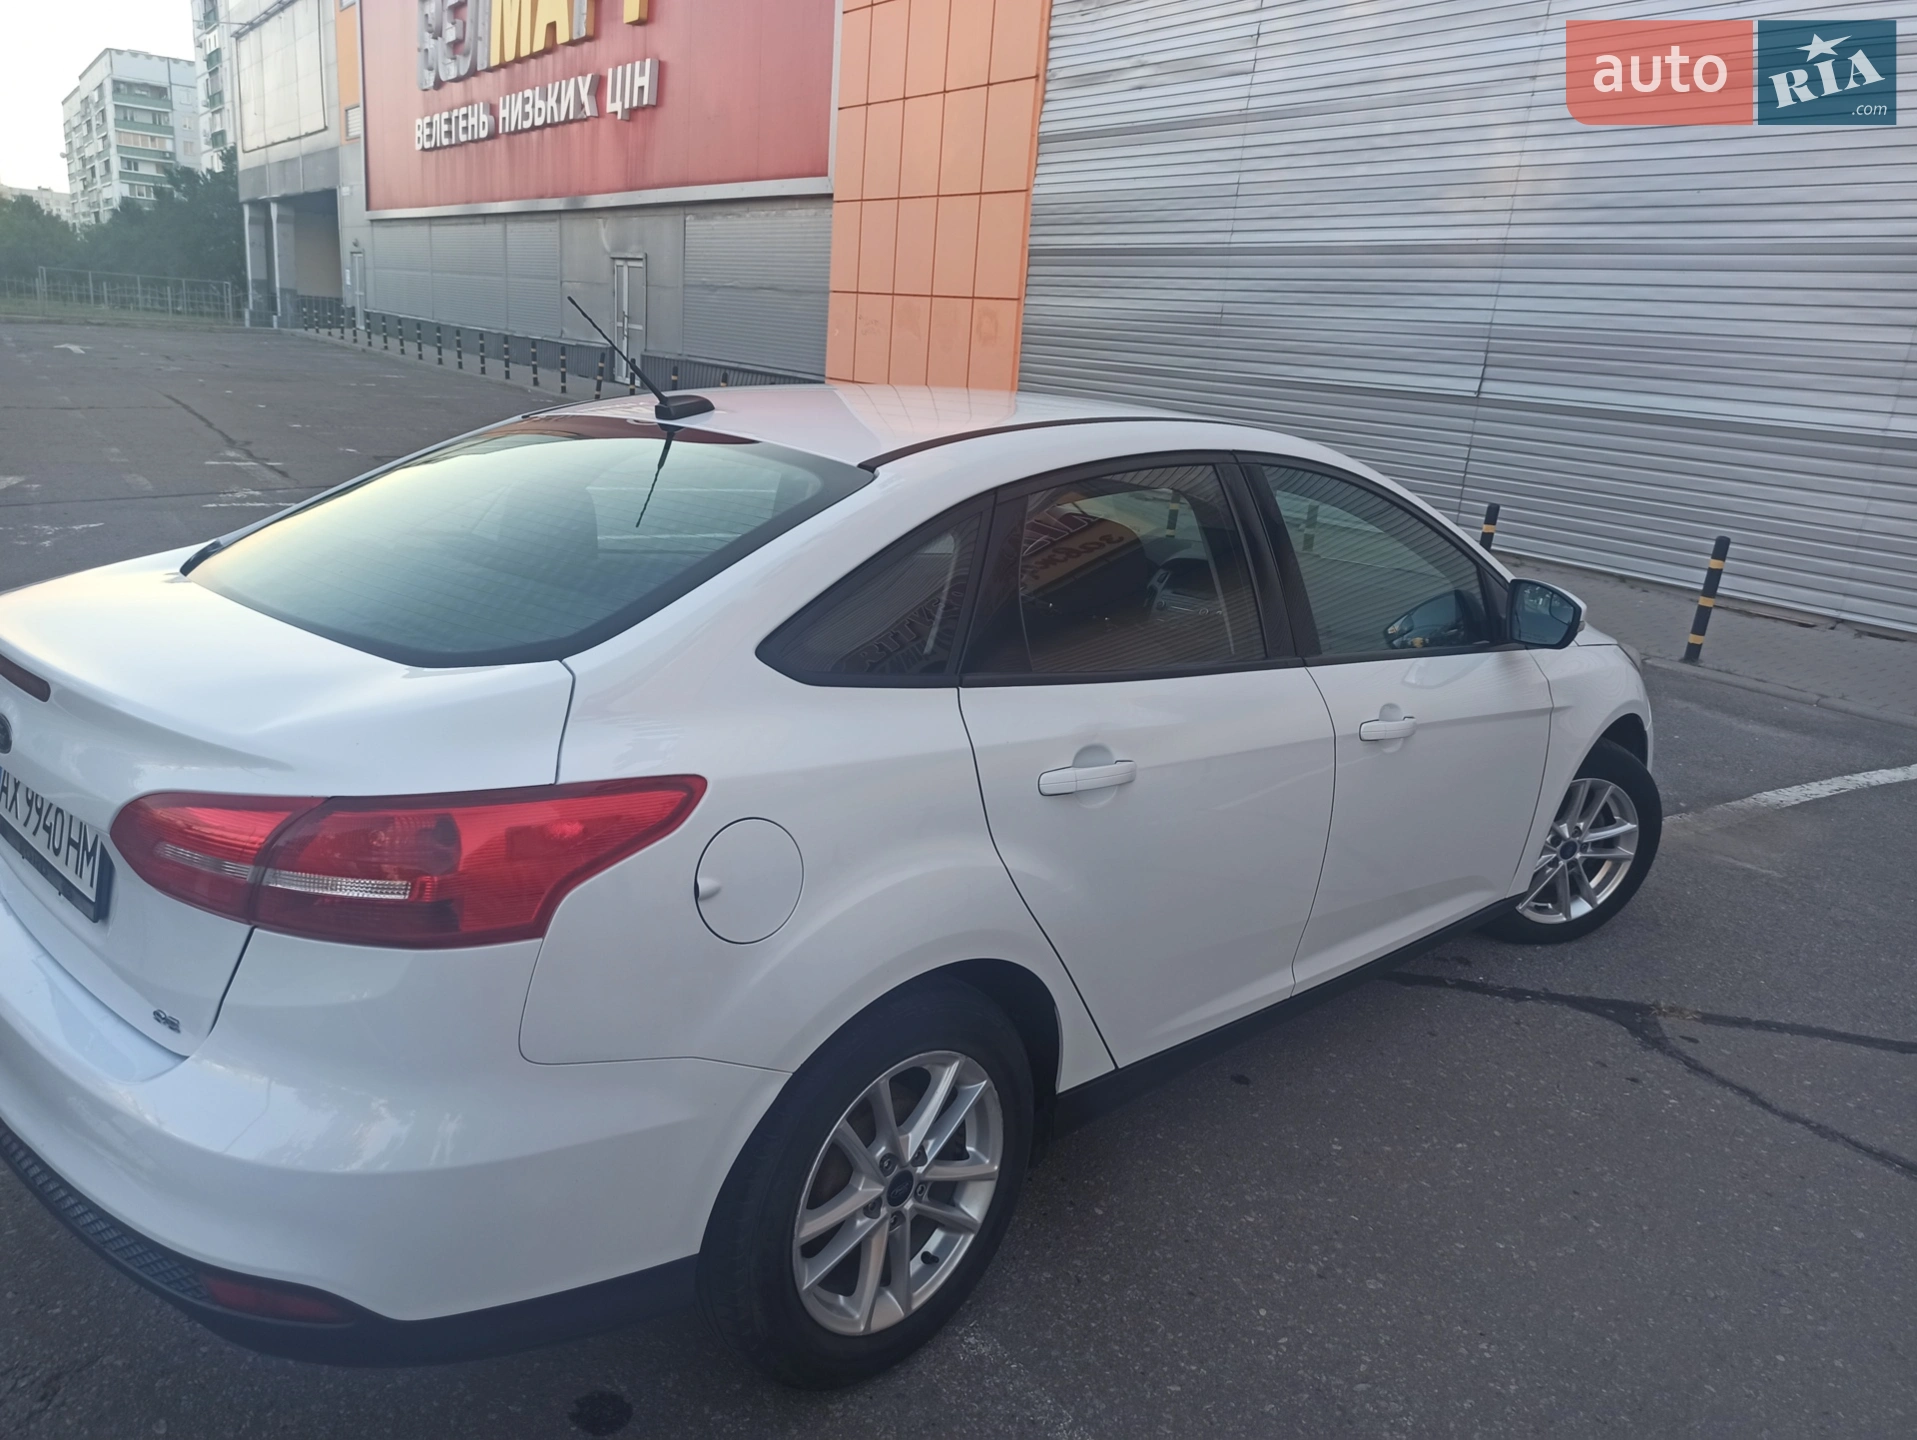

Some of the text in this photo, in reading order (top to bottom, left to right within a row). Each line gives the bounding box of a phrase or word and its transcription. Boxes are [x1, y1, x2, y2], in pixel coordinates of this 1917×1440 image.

[417, 0, 650, 90] ВЕЛМА
[499, 73, 597, 134] НИЗЬКИХ
[606, 58, 656, 120] ЦІН
[23, 786, 65, 857] 9940
[65, 814, 99, 889] HM
